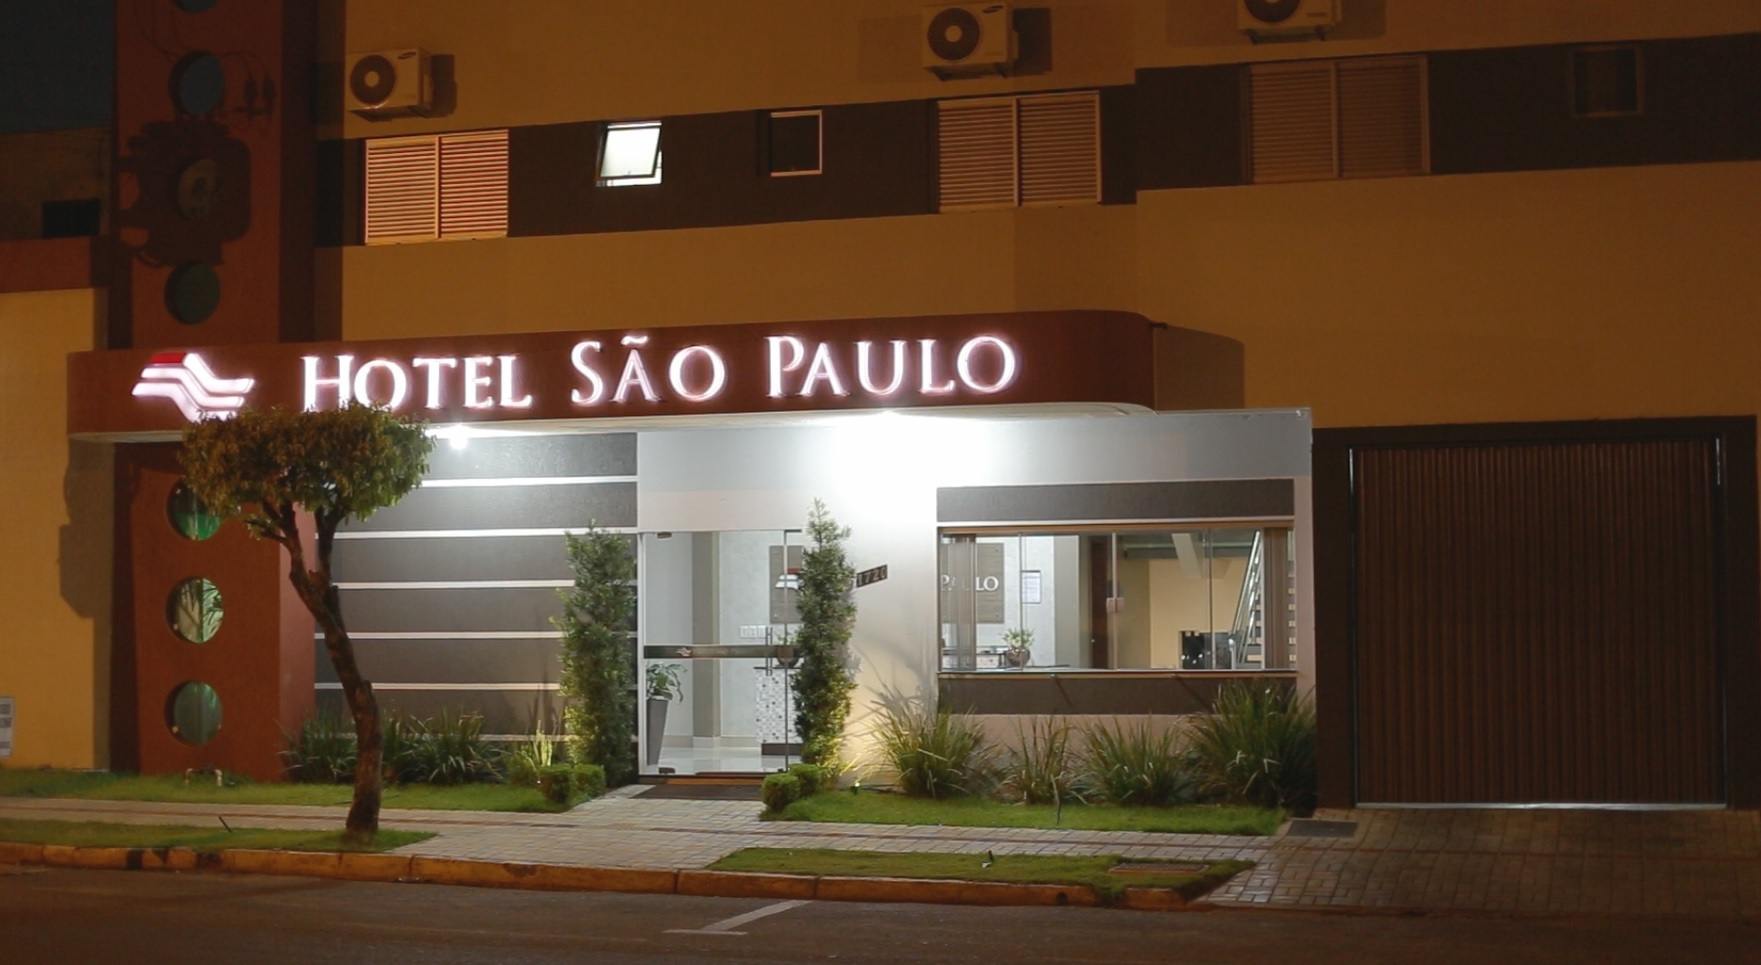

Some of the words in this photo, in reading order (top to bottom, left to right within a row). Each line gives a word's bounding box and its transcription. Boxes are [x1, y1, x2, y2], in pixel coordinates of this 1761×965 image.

[301, 353, 534, 412] HOTEL
[570, 334, 726, 406] SÃO
[764, 335, 1016, 397] PAULO
[941, 574, 999, 592] PLO
